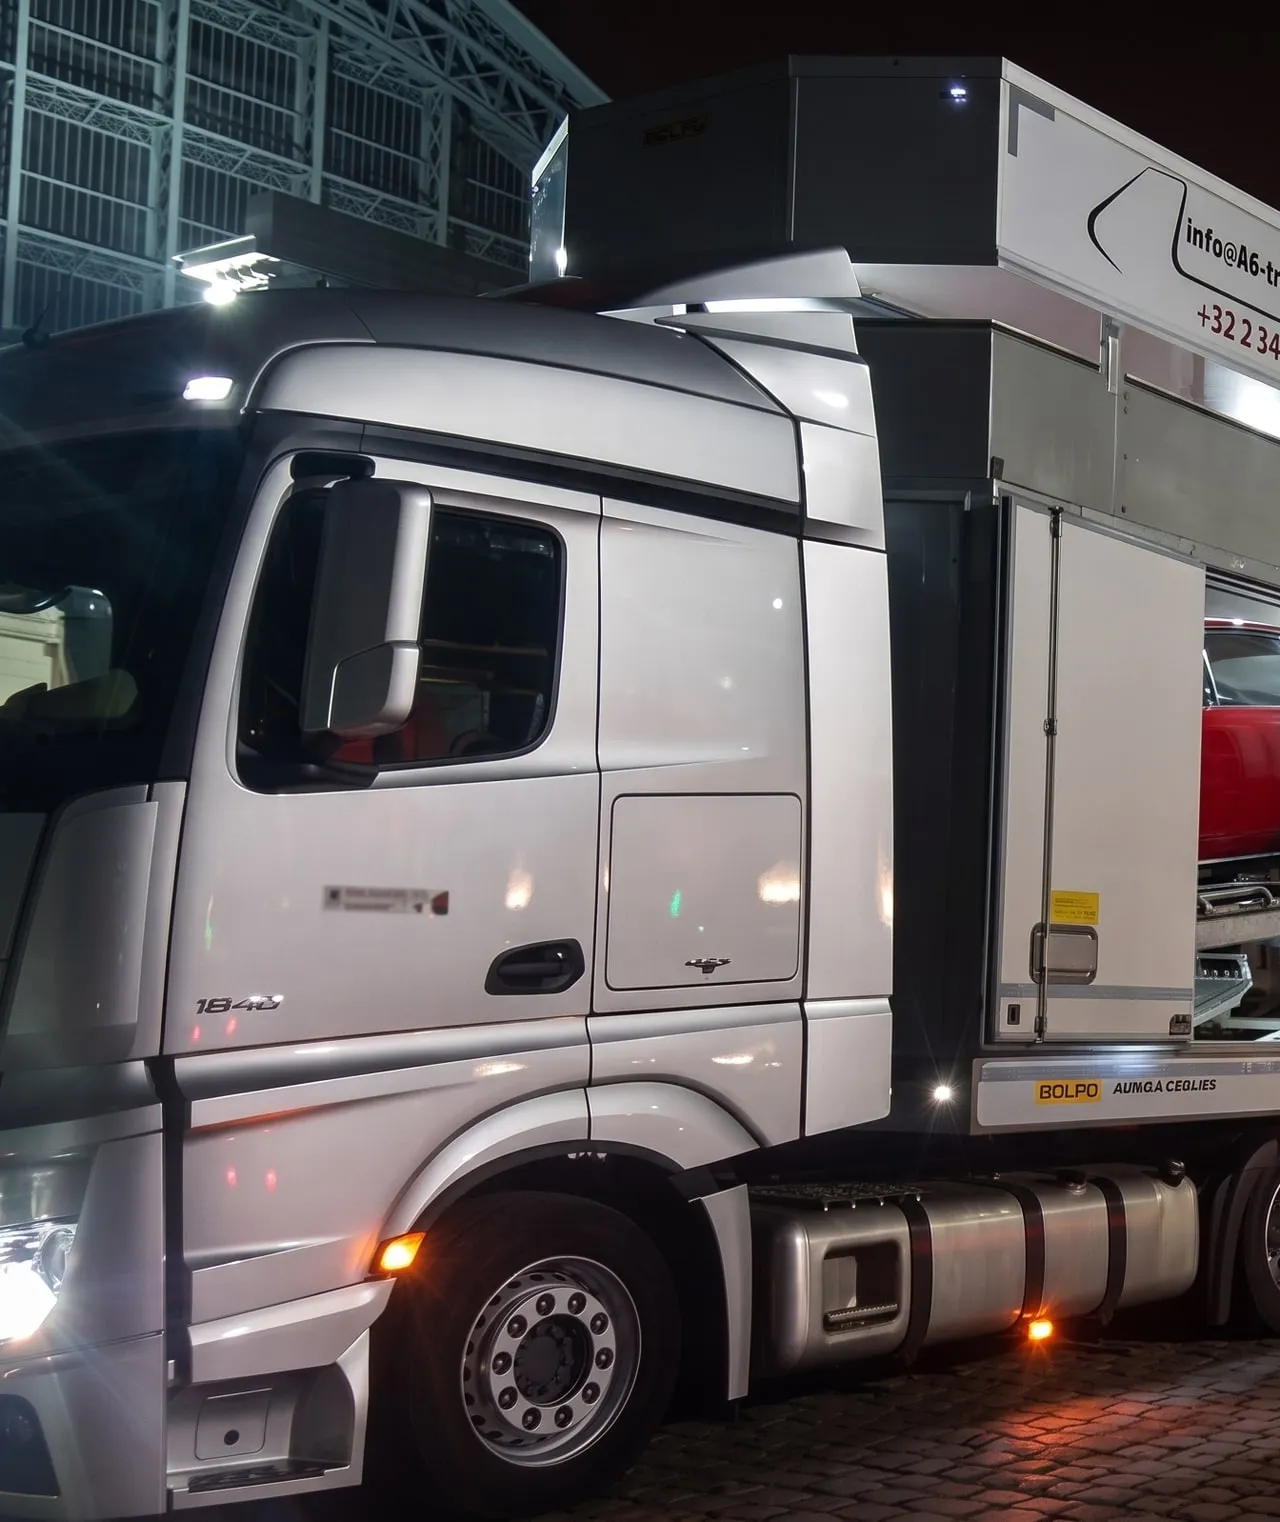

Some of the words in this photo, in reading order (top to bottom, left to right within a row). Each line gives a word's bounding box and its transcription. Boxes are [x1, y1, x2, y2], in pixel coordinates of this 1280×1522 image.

[1197, 304, 1236, 341] +32
[1240, 318, 1252, 348] 2
[1039, 1083, 1099, 1100] BOLPO
